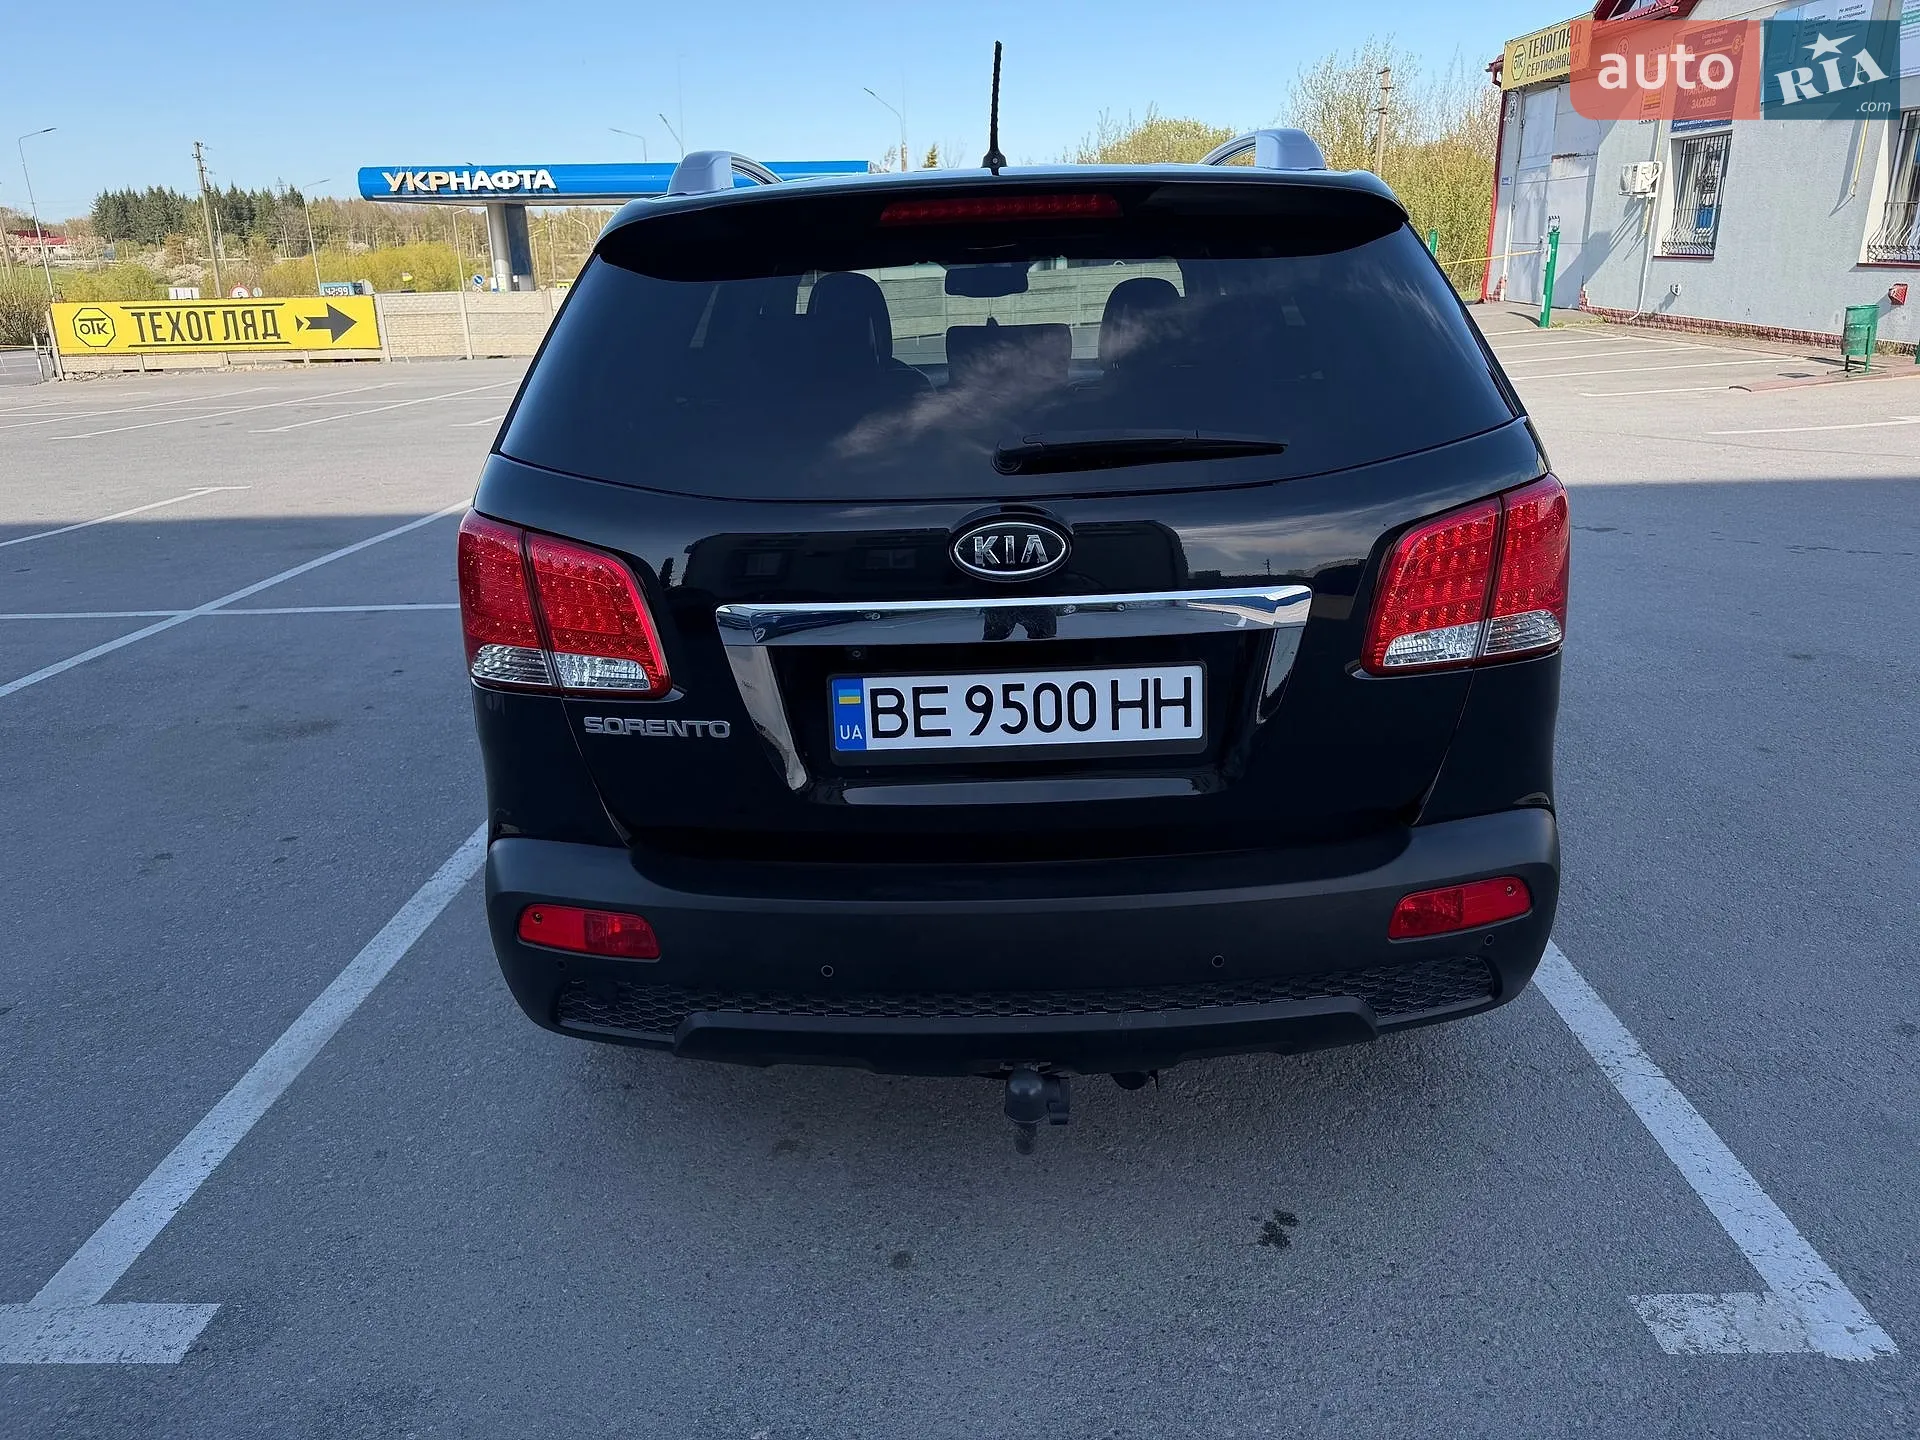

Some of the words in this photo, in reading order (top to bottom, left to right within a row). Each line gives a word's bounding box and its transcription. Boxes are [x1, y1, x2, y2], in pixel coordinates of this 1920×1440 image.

[1528, 24, 1581, 59] ТЕХОГЛЯД
[382, 169, 556, 192] УКРНАФТА
[80, 318, 109, 335] ОТК
[131, 310, 281, 342] ТЕХОГЛЯД
[973, 534, 1047, 567] KIA
[870, 686, 952, 739] BE
[965, 680, 1097, 732] 9500
[1110, 676, 1192, 729] HH
[583, 716, 731, 738] SORENTO
[840, 725, 863, 741] UA
